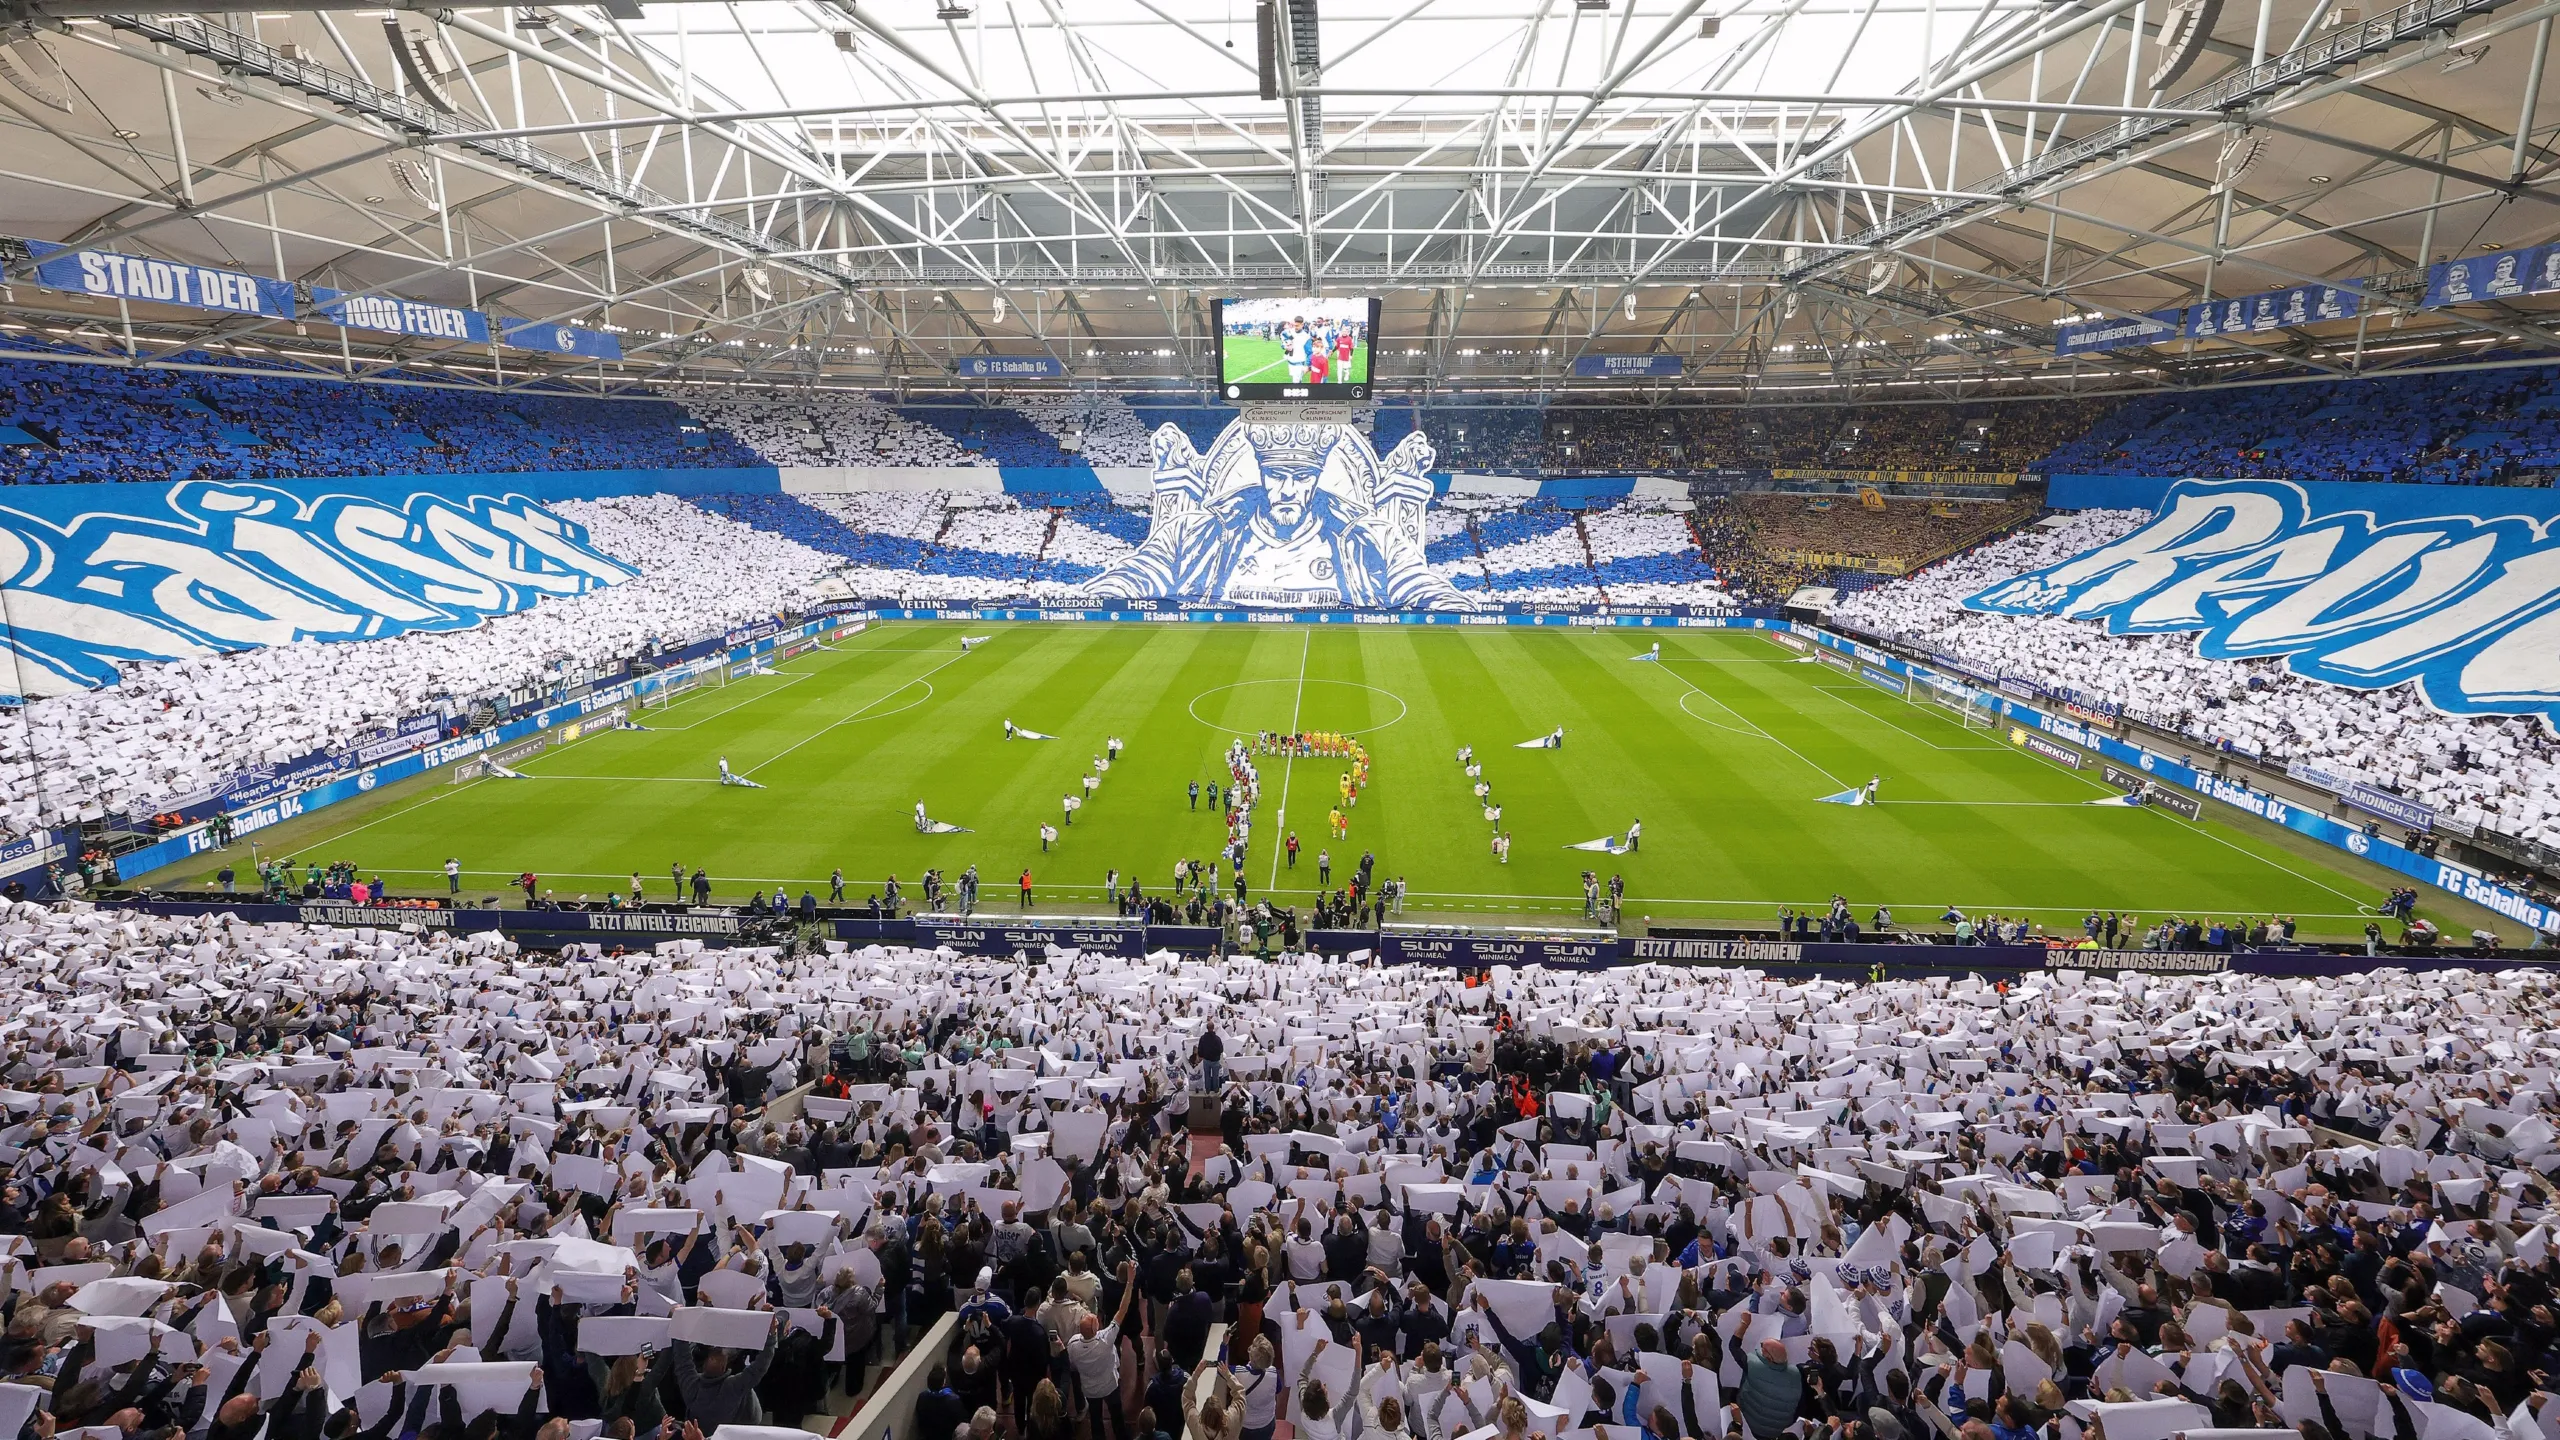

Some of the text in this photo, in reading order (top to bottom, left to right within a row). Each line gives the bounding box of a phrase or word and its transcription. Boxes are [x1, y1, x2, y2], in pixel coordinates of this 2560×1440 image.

[79, 252, 260, 312] STADT DER
[2495, 285, 2523, 296] FISCHER
[345, 295, 468, 338] 1000 FEUER
[991, 362, 1047, 372] FC Schalke 04
[1604, 357, 1653, 368] #STEHTAUF
[1792, 470, 1997, 484] BRAUNSCHWEIGER TURN- UND SPORTVEREIN
[817, 601, 838, 615] BOYS
[840, 601, 866, 611] SOLMS
[898, 600, 948, 609] VELTINS
[1039, 600, 1104, 608] HAGEDORN
[1127, 600, 1158, 610] HRS
[1534, 604, 1581, 612] HEGMANNS
[868, 610, 879, 620] 04
[937, 610, 945, 619] FC
[1040, 611, 1048, 620] FC
[1144, 612, 1152, 621] FC
[1248, 613, 1257, 622] FC
[1689, 607, 1743, 617] VELTINS
[1354, 614, 1362, 624] FC
[1460, 615, 1469, 625] FC
[1568, 616, 1577, 626] FC
[1606, 616, 1616, 626] 04
[1678, 617, 1687, 627] FC
[580, 700, 591, 714] FC
[593, 688, 622, 710] Schalke
[623, 685, 634, 698] 04
[2066, 702, 2115, 726] COBURG
[584, 709, 628, 732] MERKR
[2040, 715, 2101, 751] FC Schalke 04
[423, 730, 501, 769] FC Schalke 04
[2029, 738, 2077, 765] MERKUR
[291, 761, 334, 780] Rheinberg
[2195, 773, 2287, 823] FC Schalke 04
[188, 797, 303, 853] FC chalke 04
[0, 843, 33, 861] ese
[2437, 865, 2560, 931] FC Schalke 0
[299, 907, 455, 927] S04.DE/GENOSSENSCHAFT
[588, 914, 740, 934] JETZT ANTEILE ZEICHNEN!
[935, 930, 985, 940] SUN
[1004, 932, 1055, 942] SUN
[1072, 933, 1123, 943] SUN
[942, 940, 980, 948] MINIMEAL
[1400, 941, 1452, 951] SUN
[1472, 943, 1524, 954] SUN
[1407, 951, 1447, 959] MINIMEAL
[1543, 945, 1596, 956] SUN
[1633, 940, 1802, 960] JETZT ANTEILE ZEICHNEN!
[1478, 953, 1518, 961] MINIMEAL
[1550, 955, 1589, 963] MINIMEAL
[2045, 950, 2231, 971] S04.DE/GENOSSENSCHAFT
[1594, 1281, 1604, 1294] 8
